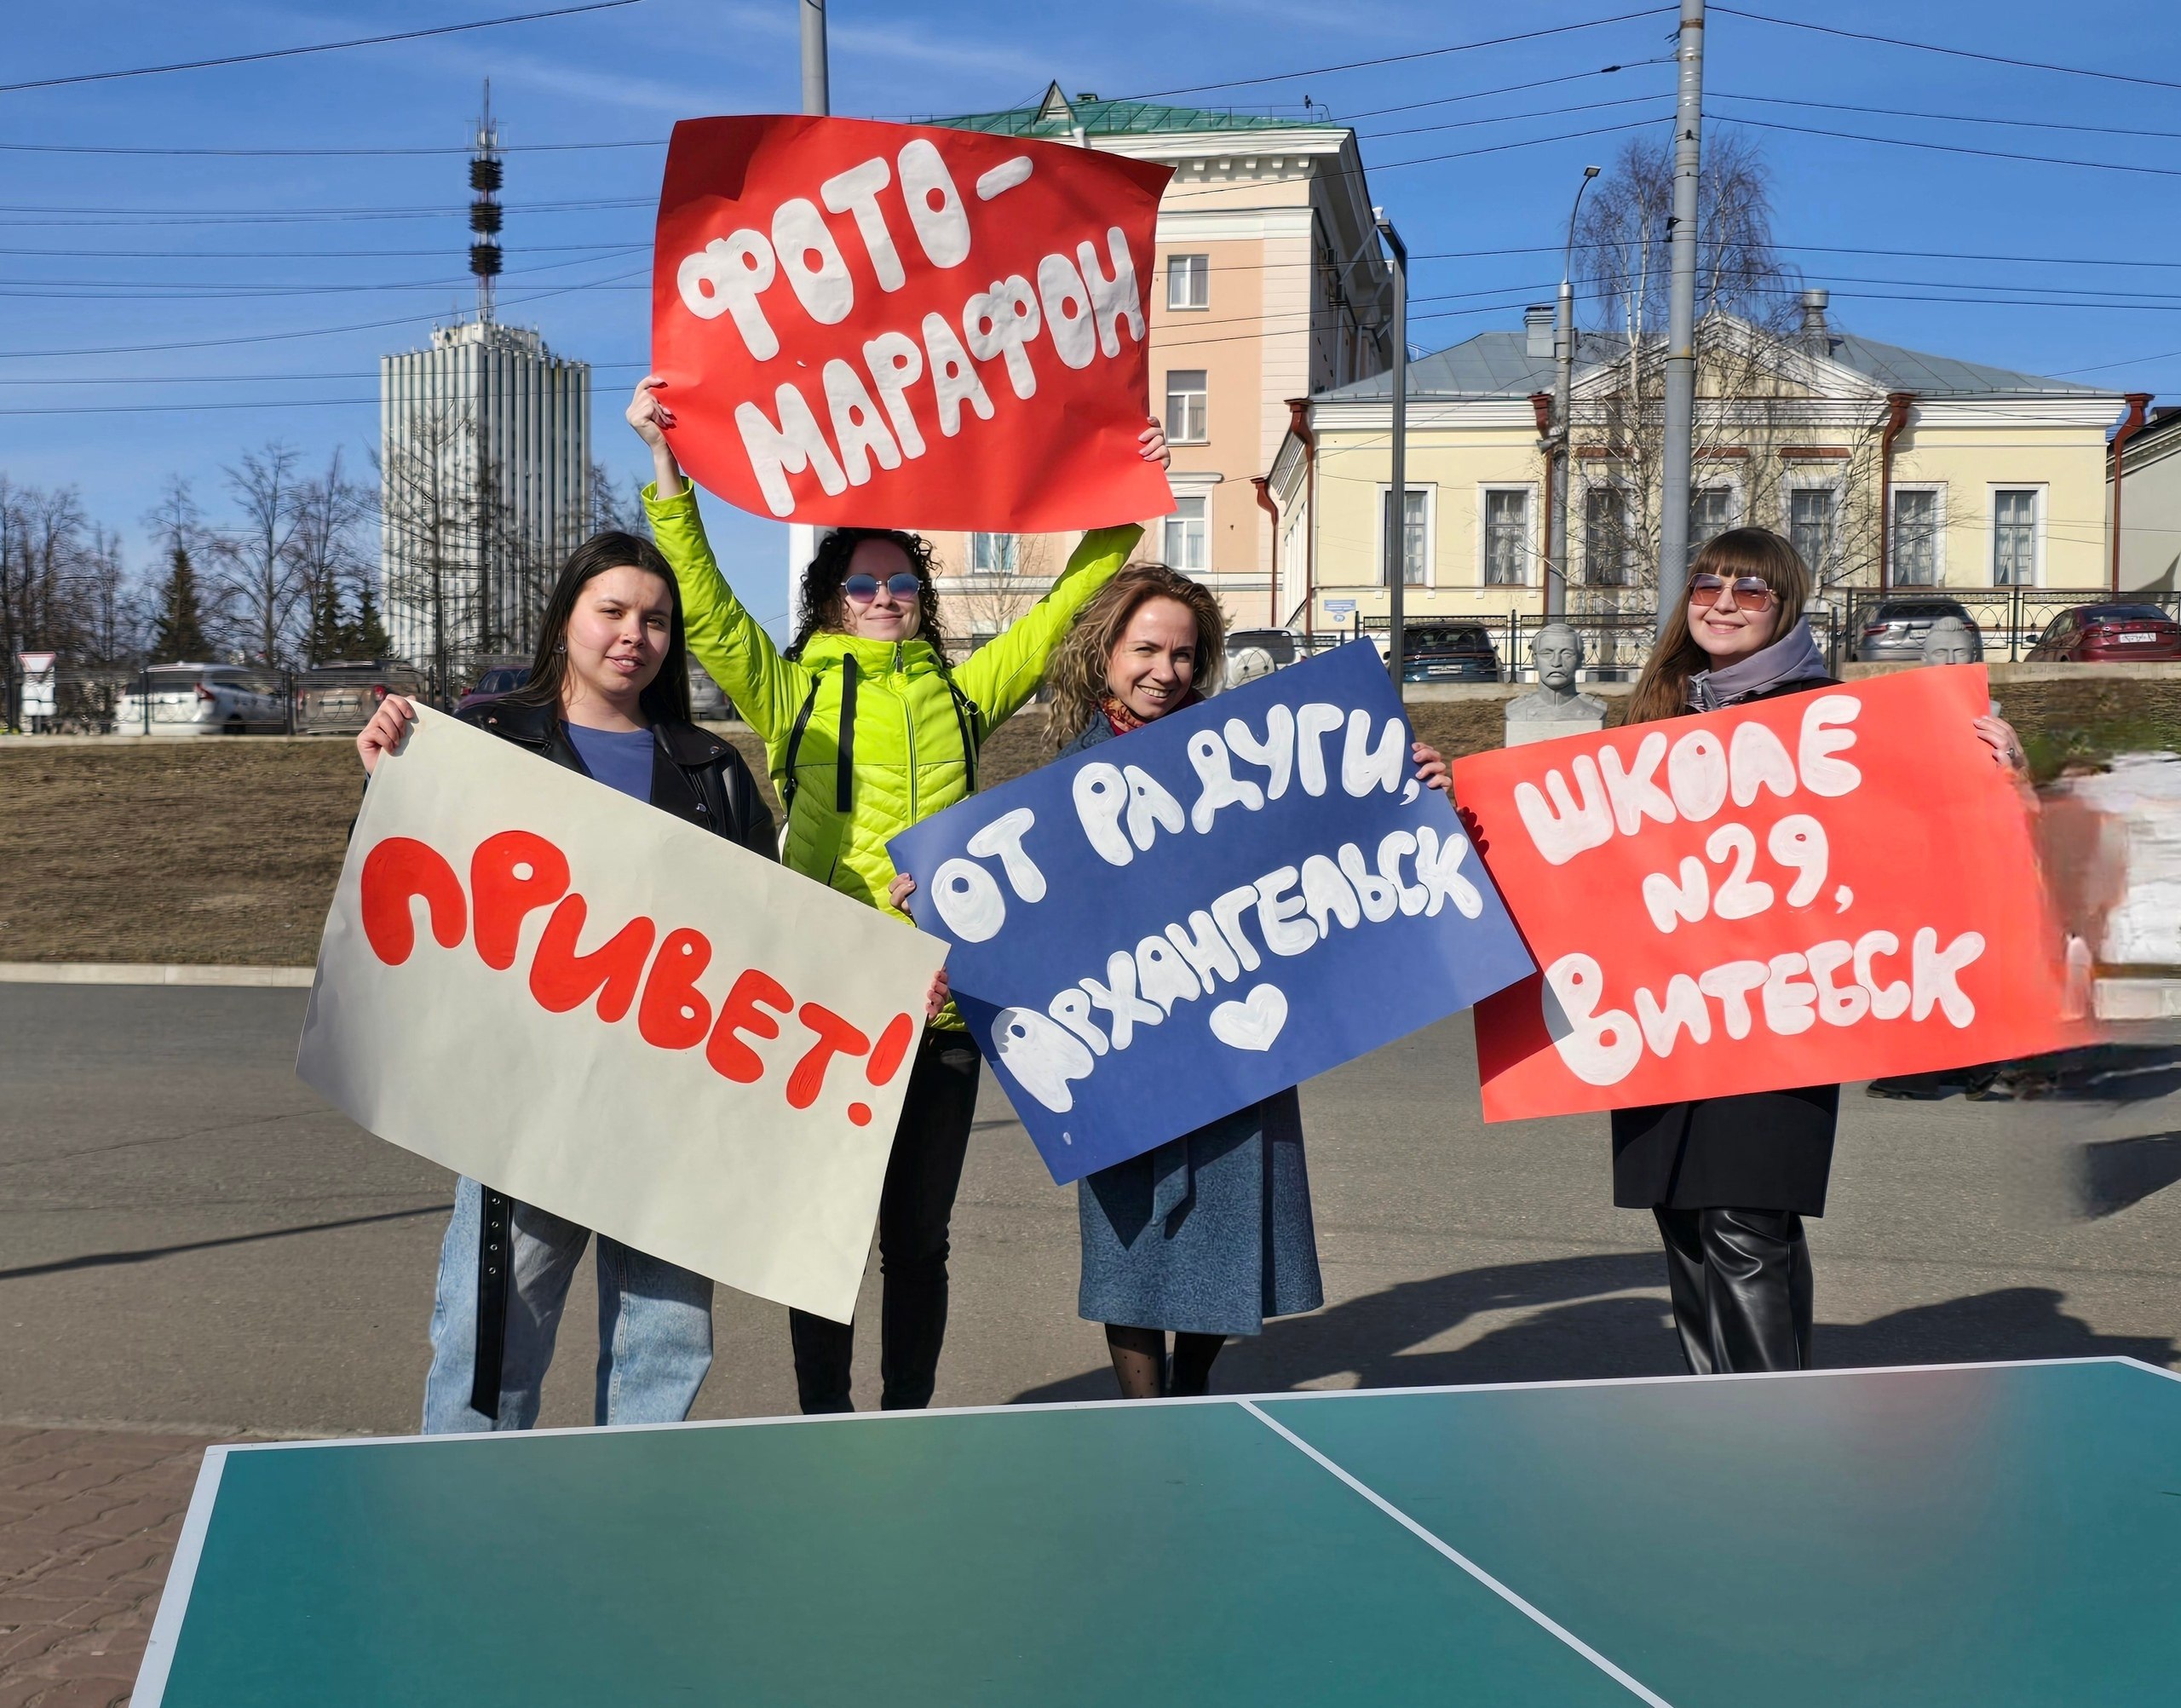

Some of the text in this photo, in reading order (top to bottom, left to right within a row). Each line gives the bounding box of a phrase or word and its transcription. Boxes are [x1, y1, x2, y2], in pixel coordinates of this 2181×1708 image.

[734, 227, 1146, 517] МАРАФОН
[931, 808, 1046, 943] ОТ
[1515, 695, 1862, 866] ШКОЛЕ
[360, 830, 913, 1126] ПРИВЕТ!
[991, 825, 1483, 1113] АРХАНГЕЛЬСК
[1541, 927, 1985, 1086] ВИТЕБСК
